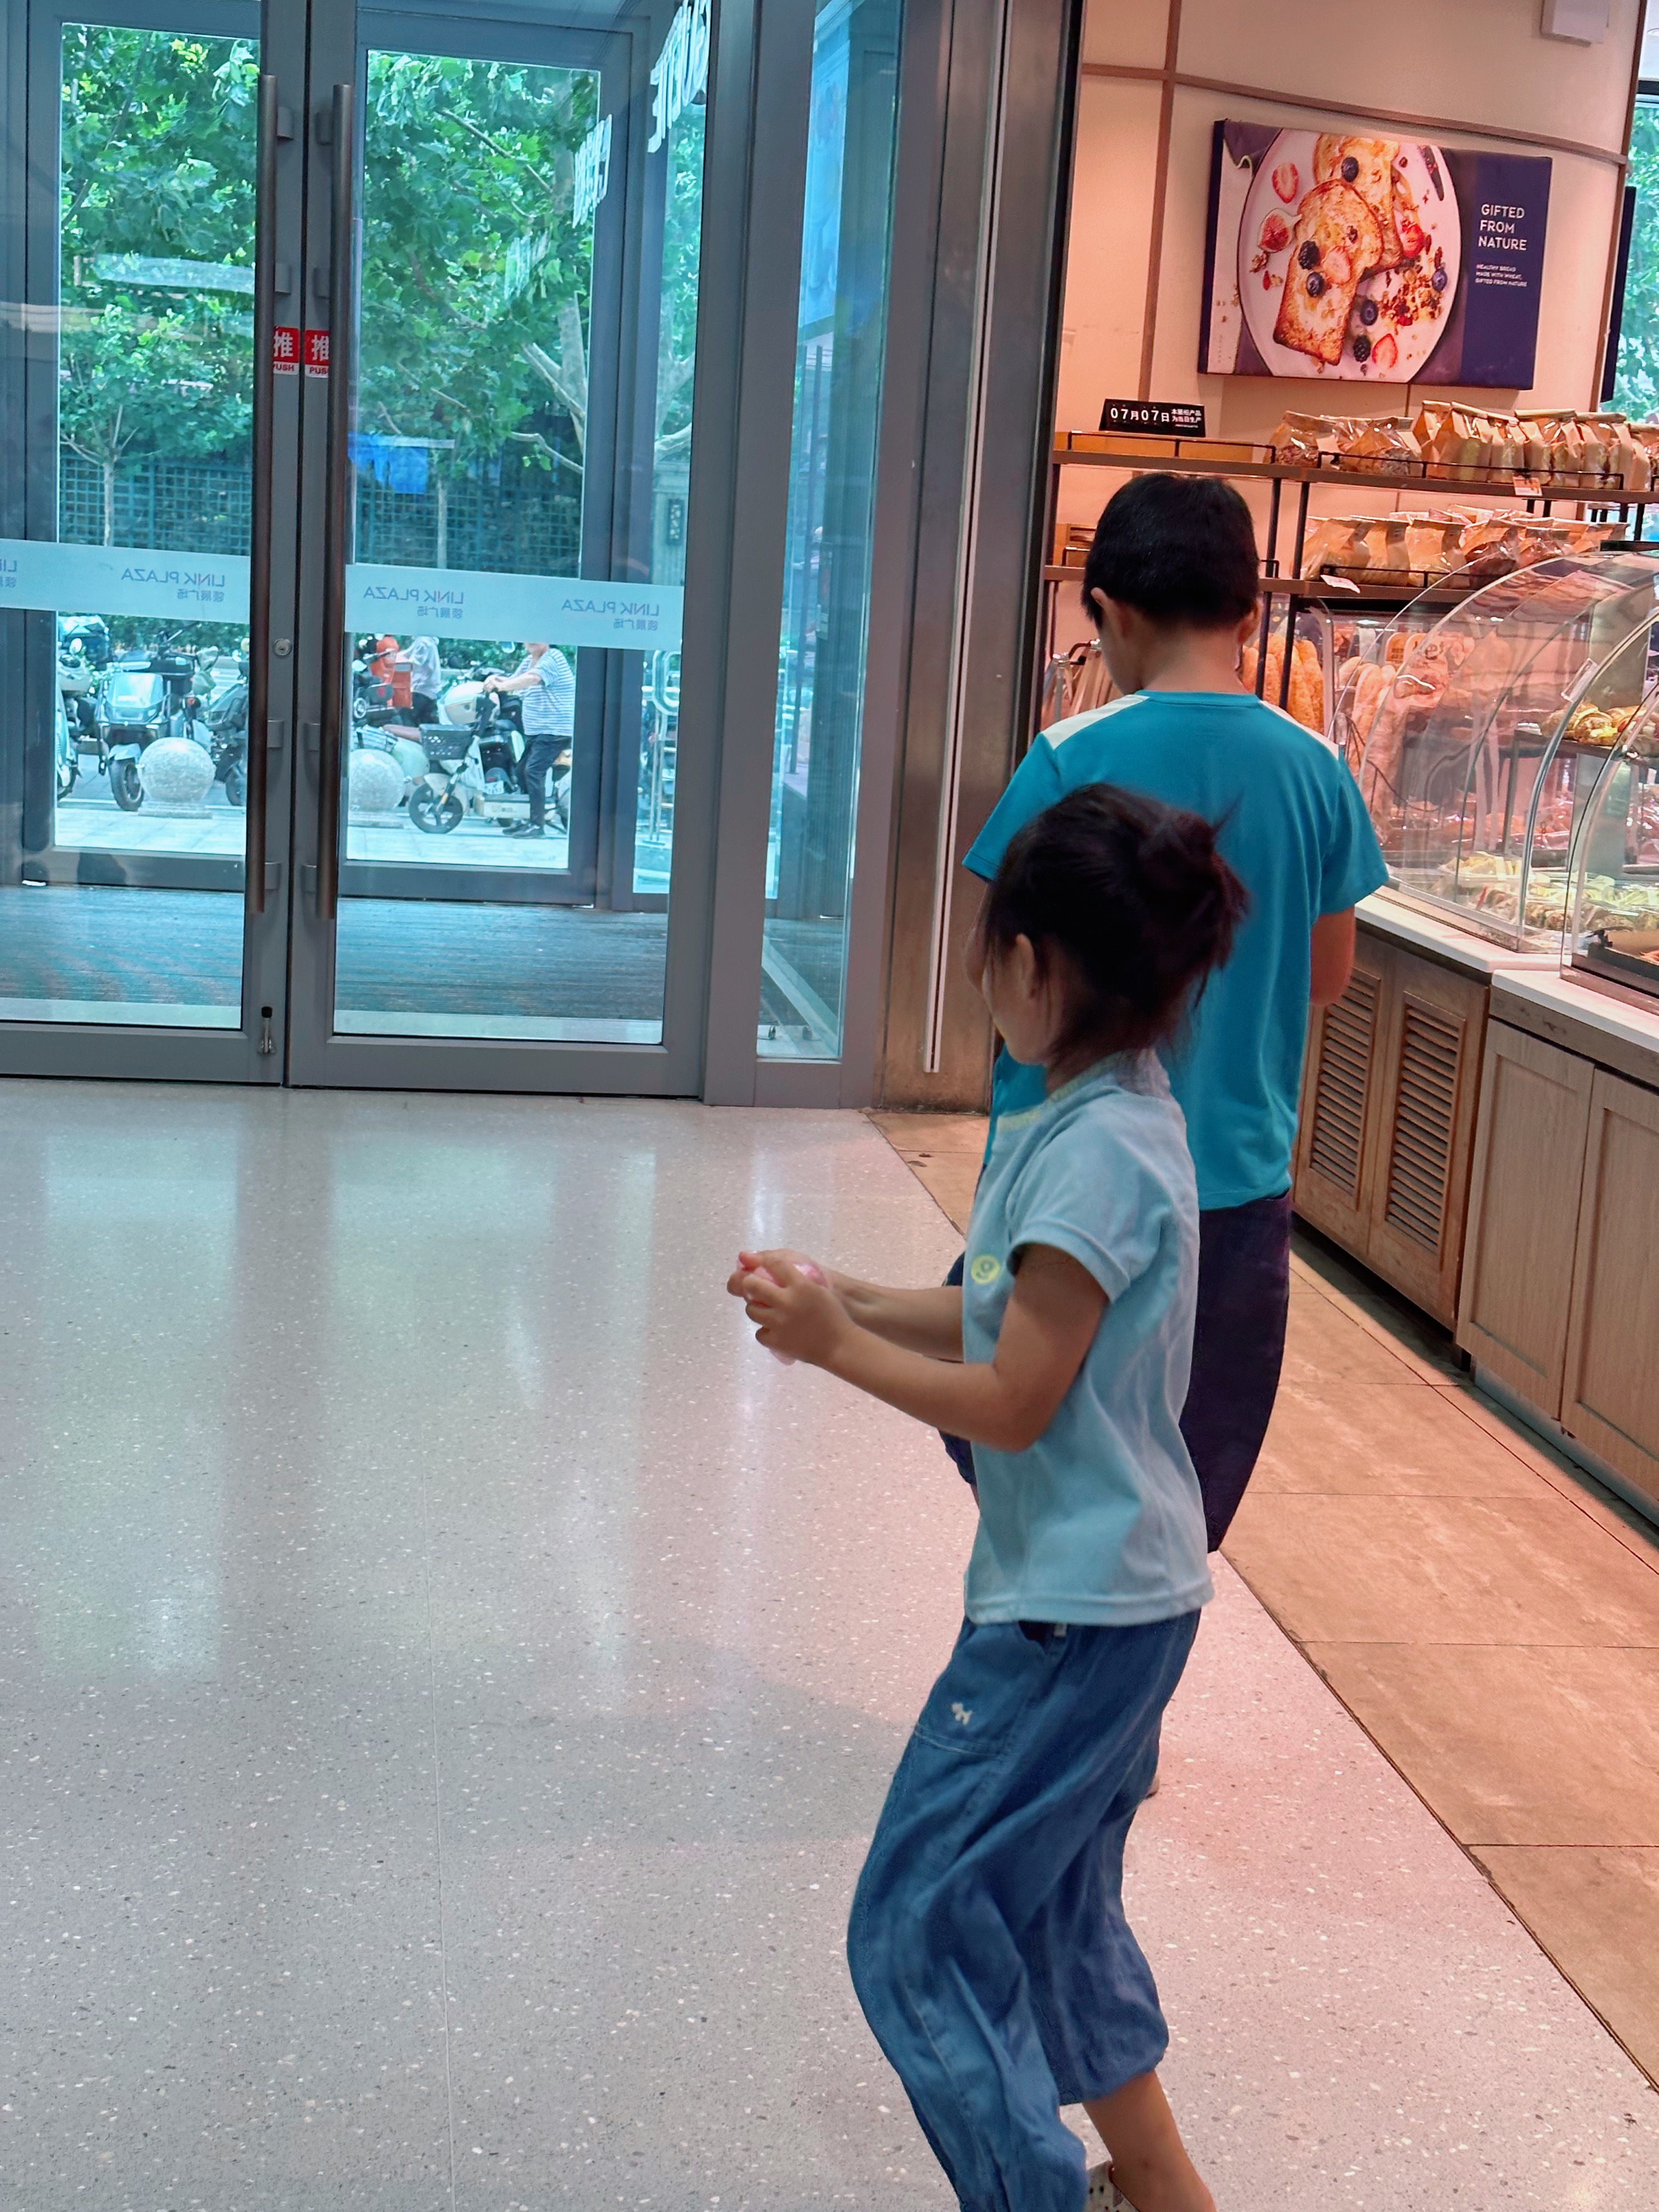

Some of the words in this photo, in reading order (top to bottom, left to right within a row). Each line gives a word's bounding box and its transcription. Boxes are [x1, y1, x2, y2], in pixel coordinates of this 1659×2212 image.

[1481, 204, 1525, 219] GIFTED
[1480, 220, 1515, 234] FROM
[1478, 236, 1527, 251] NATURE
[274, 331, 294, 358] 推
[311, 334, 329, 361] 推
